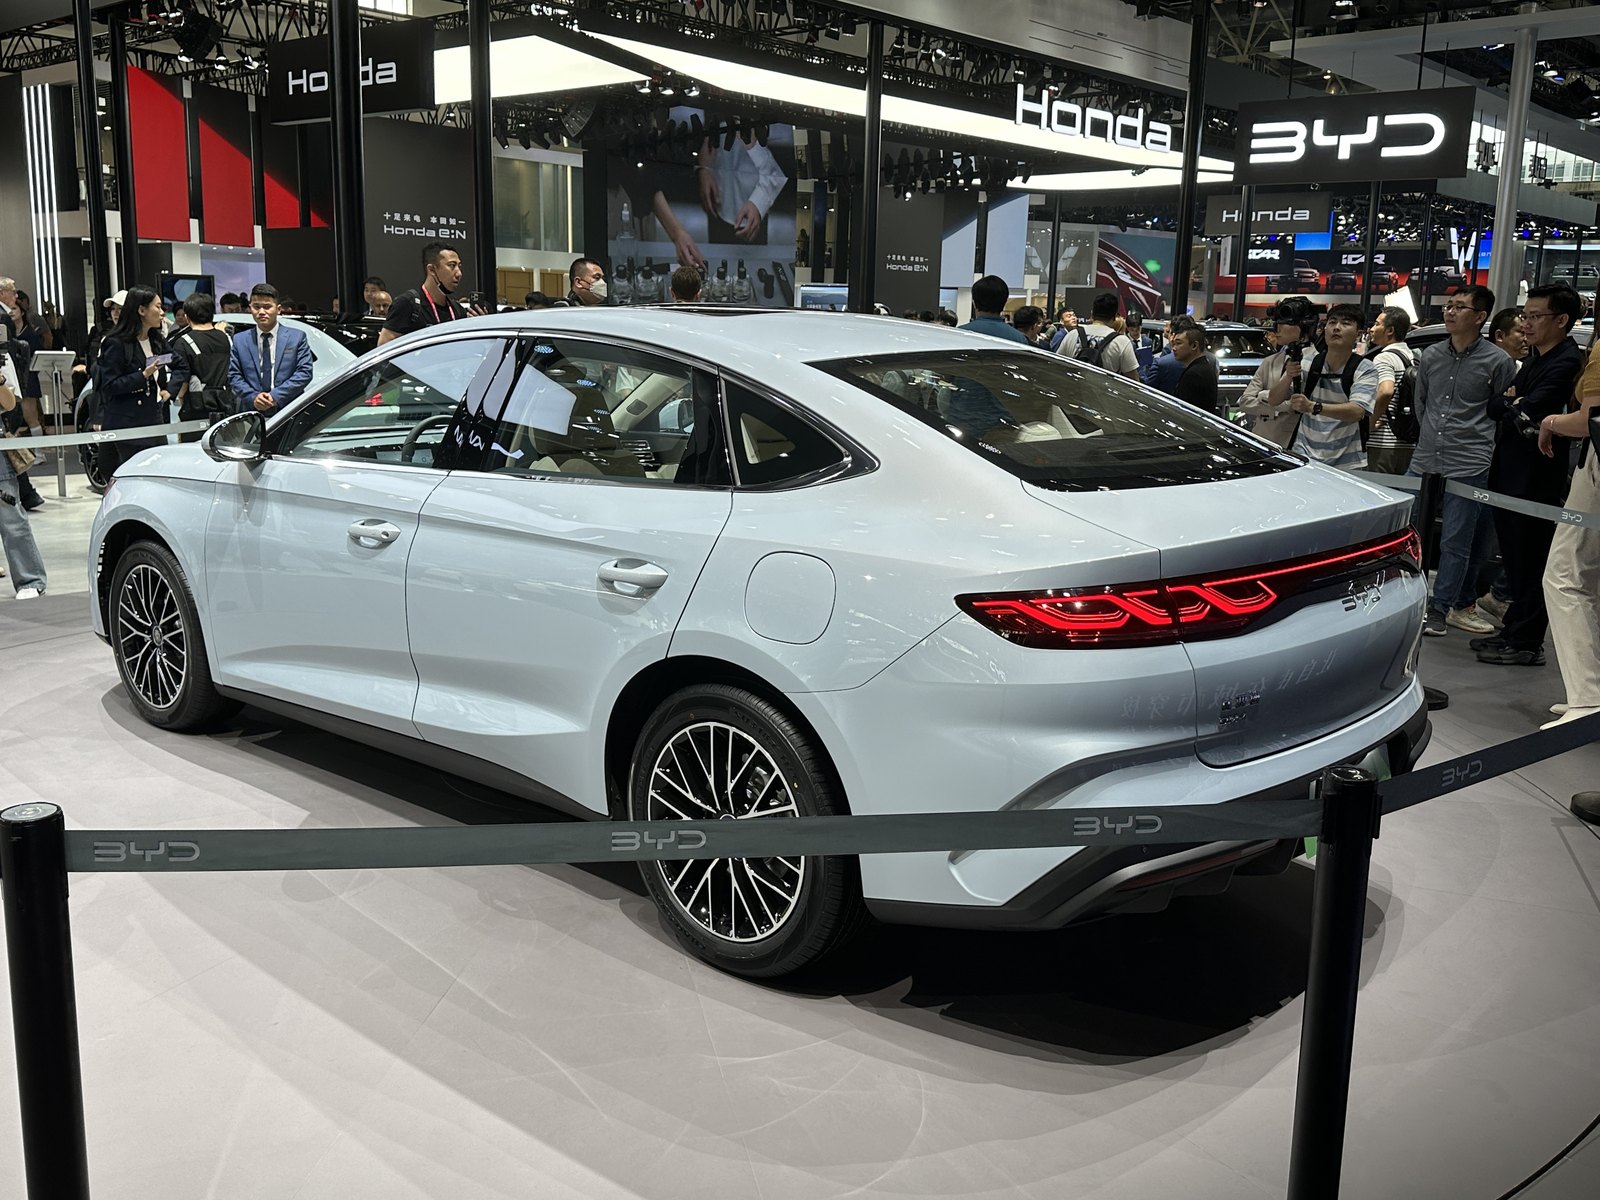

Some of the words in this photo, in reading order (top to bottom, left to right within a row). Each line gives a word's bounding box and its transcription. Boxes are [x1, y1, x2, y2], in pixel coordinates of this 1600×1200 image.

[288, 57, 397, 95] Hoda
[1015, 83, 1172, 153] Honda
[1249, 112, 1446, 164] BYD
[383, 224, 436, 238] Honda
[886, 262, 913, 272] Honda
[91, 432, 117, 441] BYD
[1472, 490, 1490, 501] BYD
[1561, 511, 1583, 523] BYD
[1441, 759, 1483, 787] BYD
[1073, 814, 1163, 836] BYD
[611, 829, 707, 852] BYD
[93, 841, 200, 863] BYD
